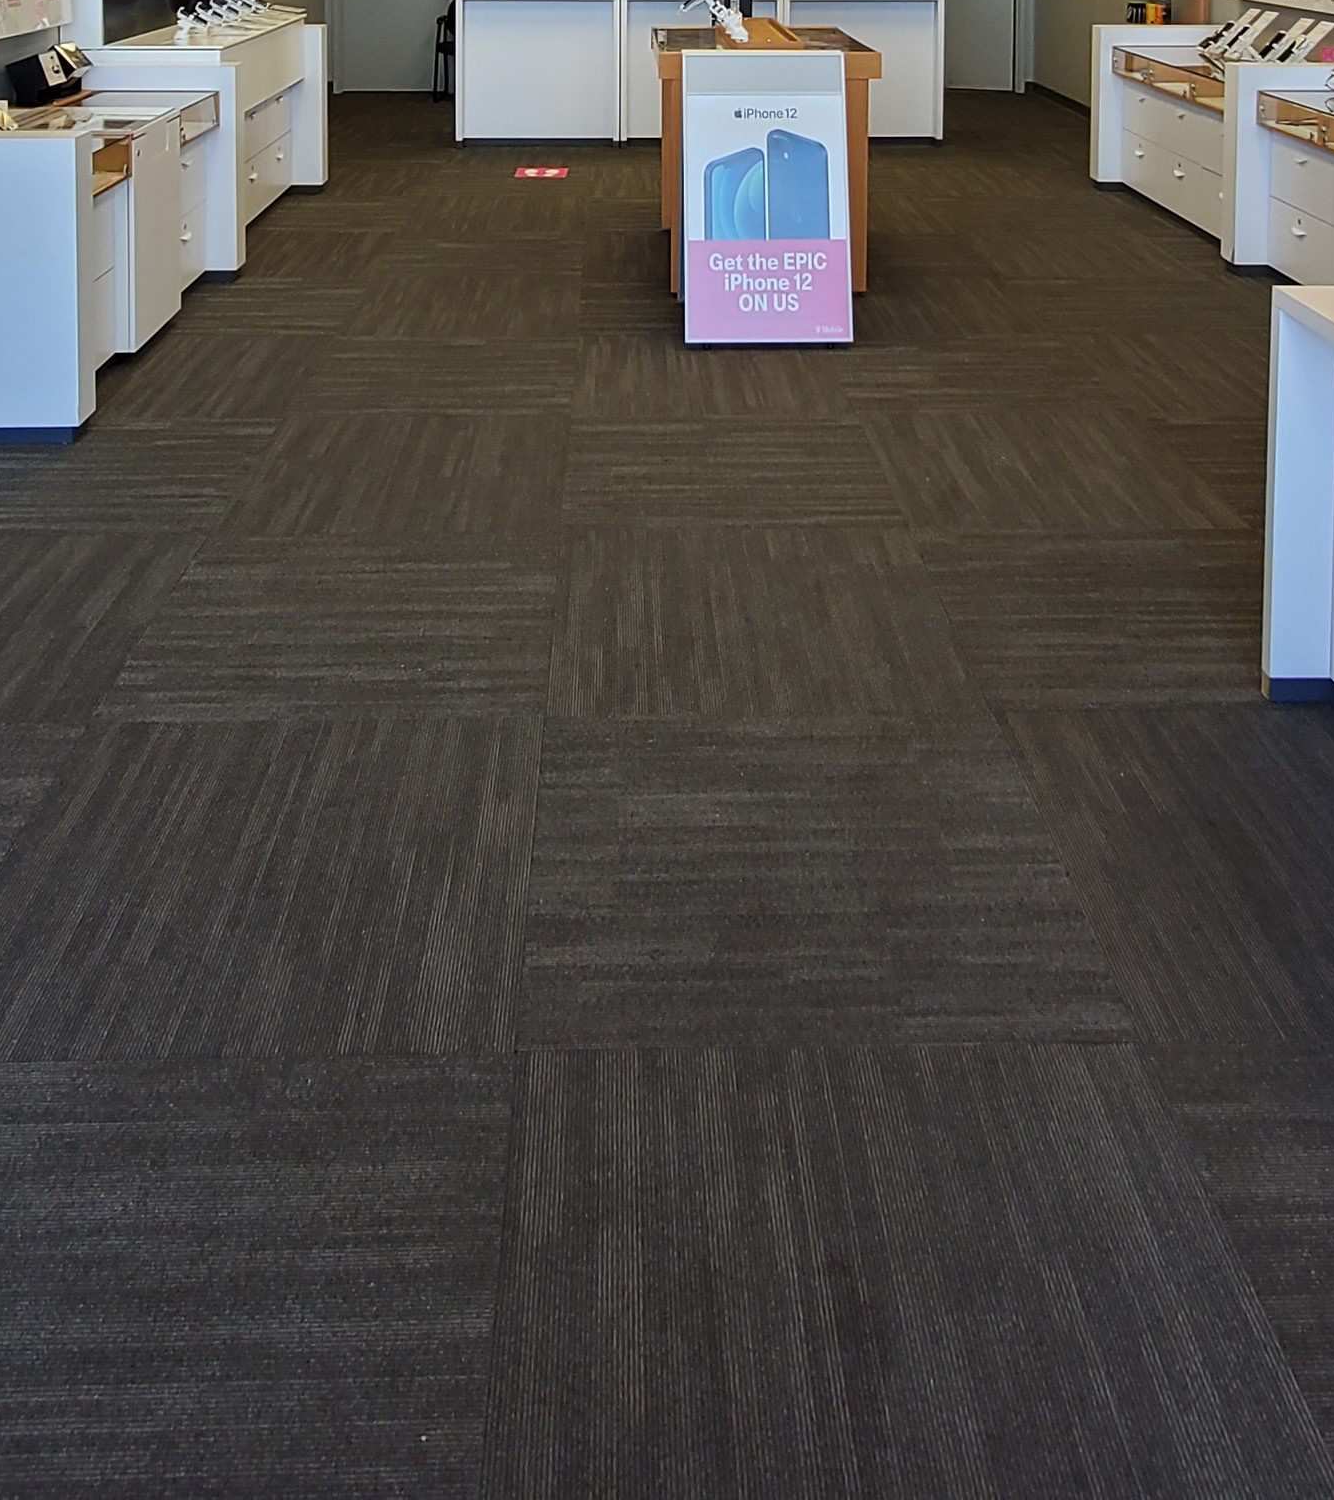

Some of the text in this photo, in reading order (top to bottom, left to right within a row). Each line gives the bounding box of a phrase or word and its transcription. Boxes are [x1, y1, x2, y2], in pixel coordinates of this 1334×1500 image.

[743, 107, 798, 119] iPhone 12
[709, 253, 828, 271] Get the EPIC
[724, 273, 813, 291] iPhone 12
[739, 294, 800, 312] ON US
